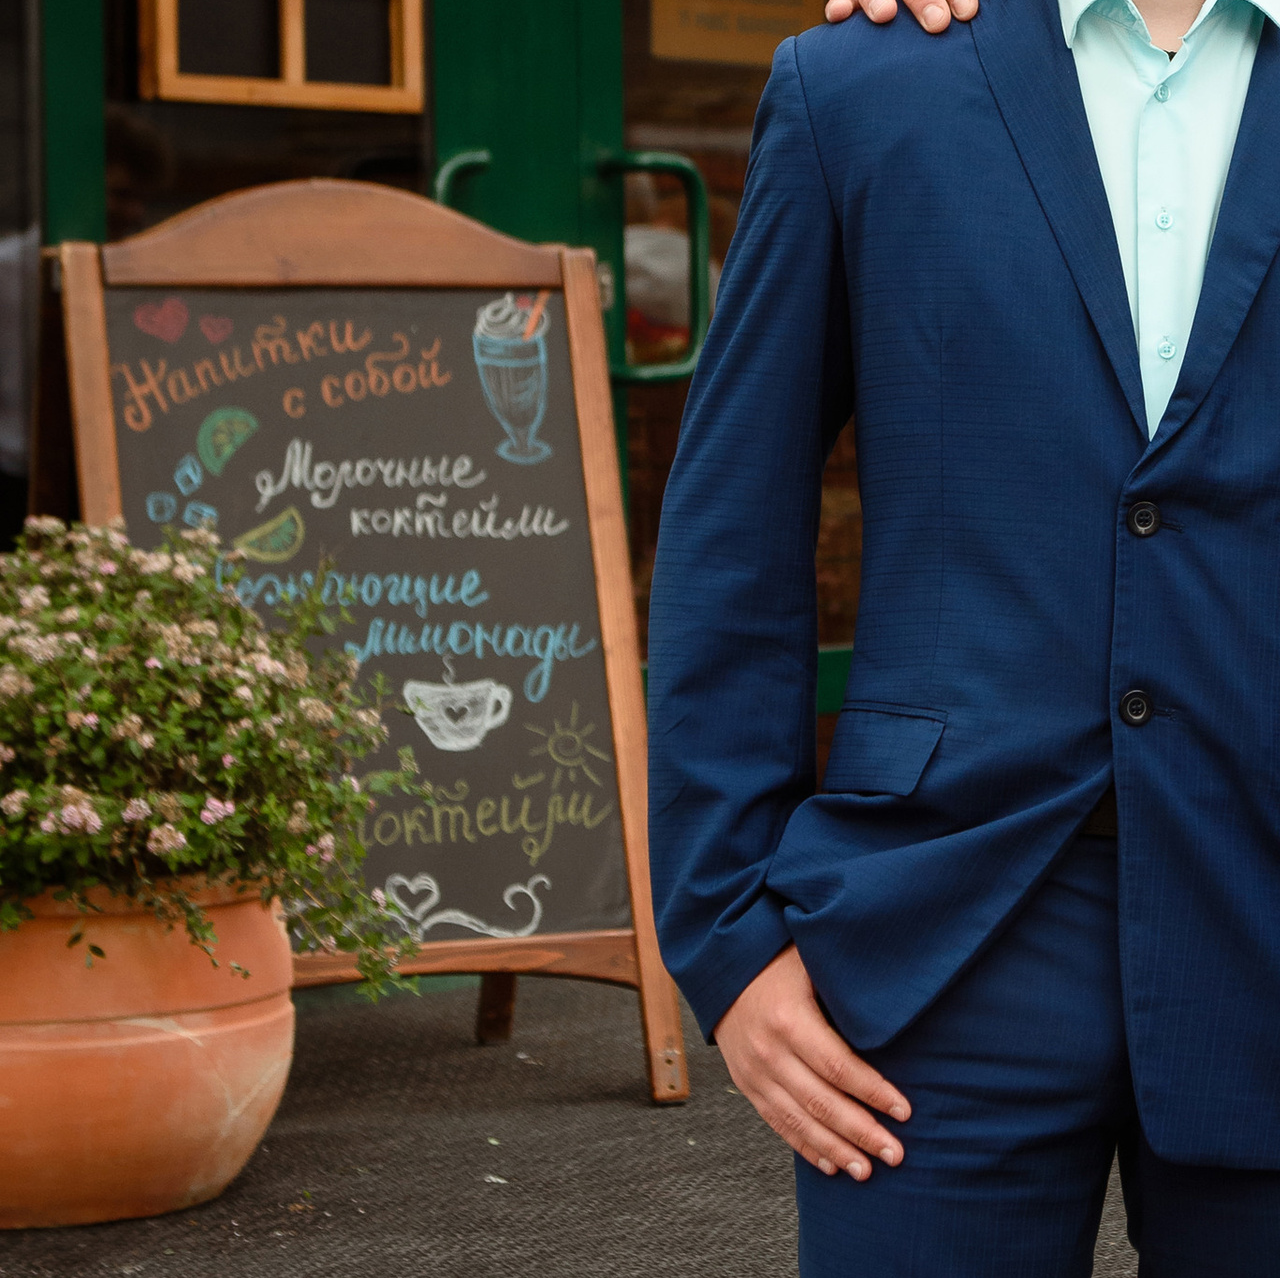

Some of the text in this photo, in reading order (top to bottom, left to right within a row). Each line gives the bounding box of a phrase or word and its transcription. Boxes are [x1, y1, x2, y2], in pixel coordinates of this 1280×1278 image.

[116, 314, 372, 433] Напитки
[282, 332, 452, 420] с собой
[254, 437, 488, 513] Молочные
[349, 492, 570, 541] коктейли
